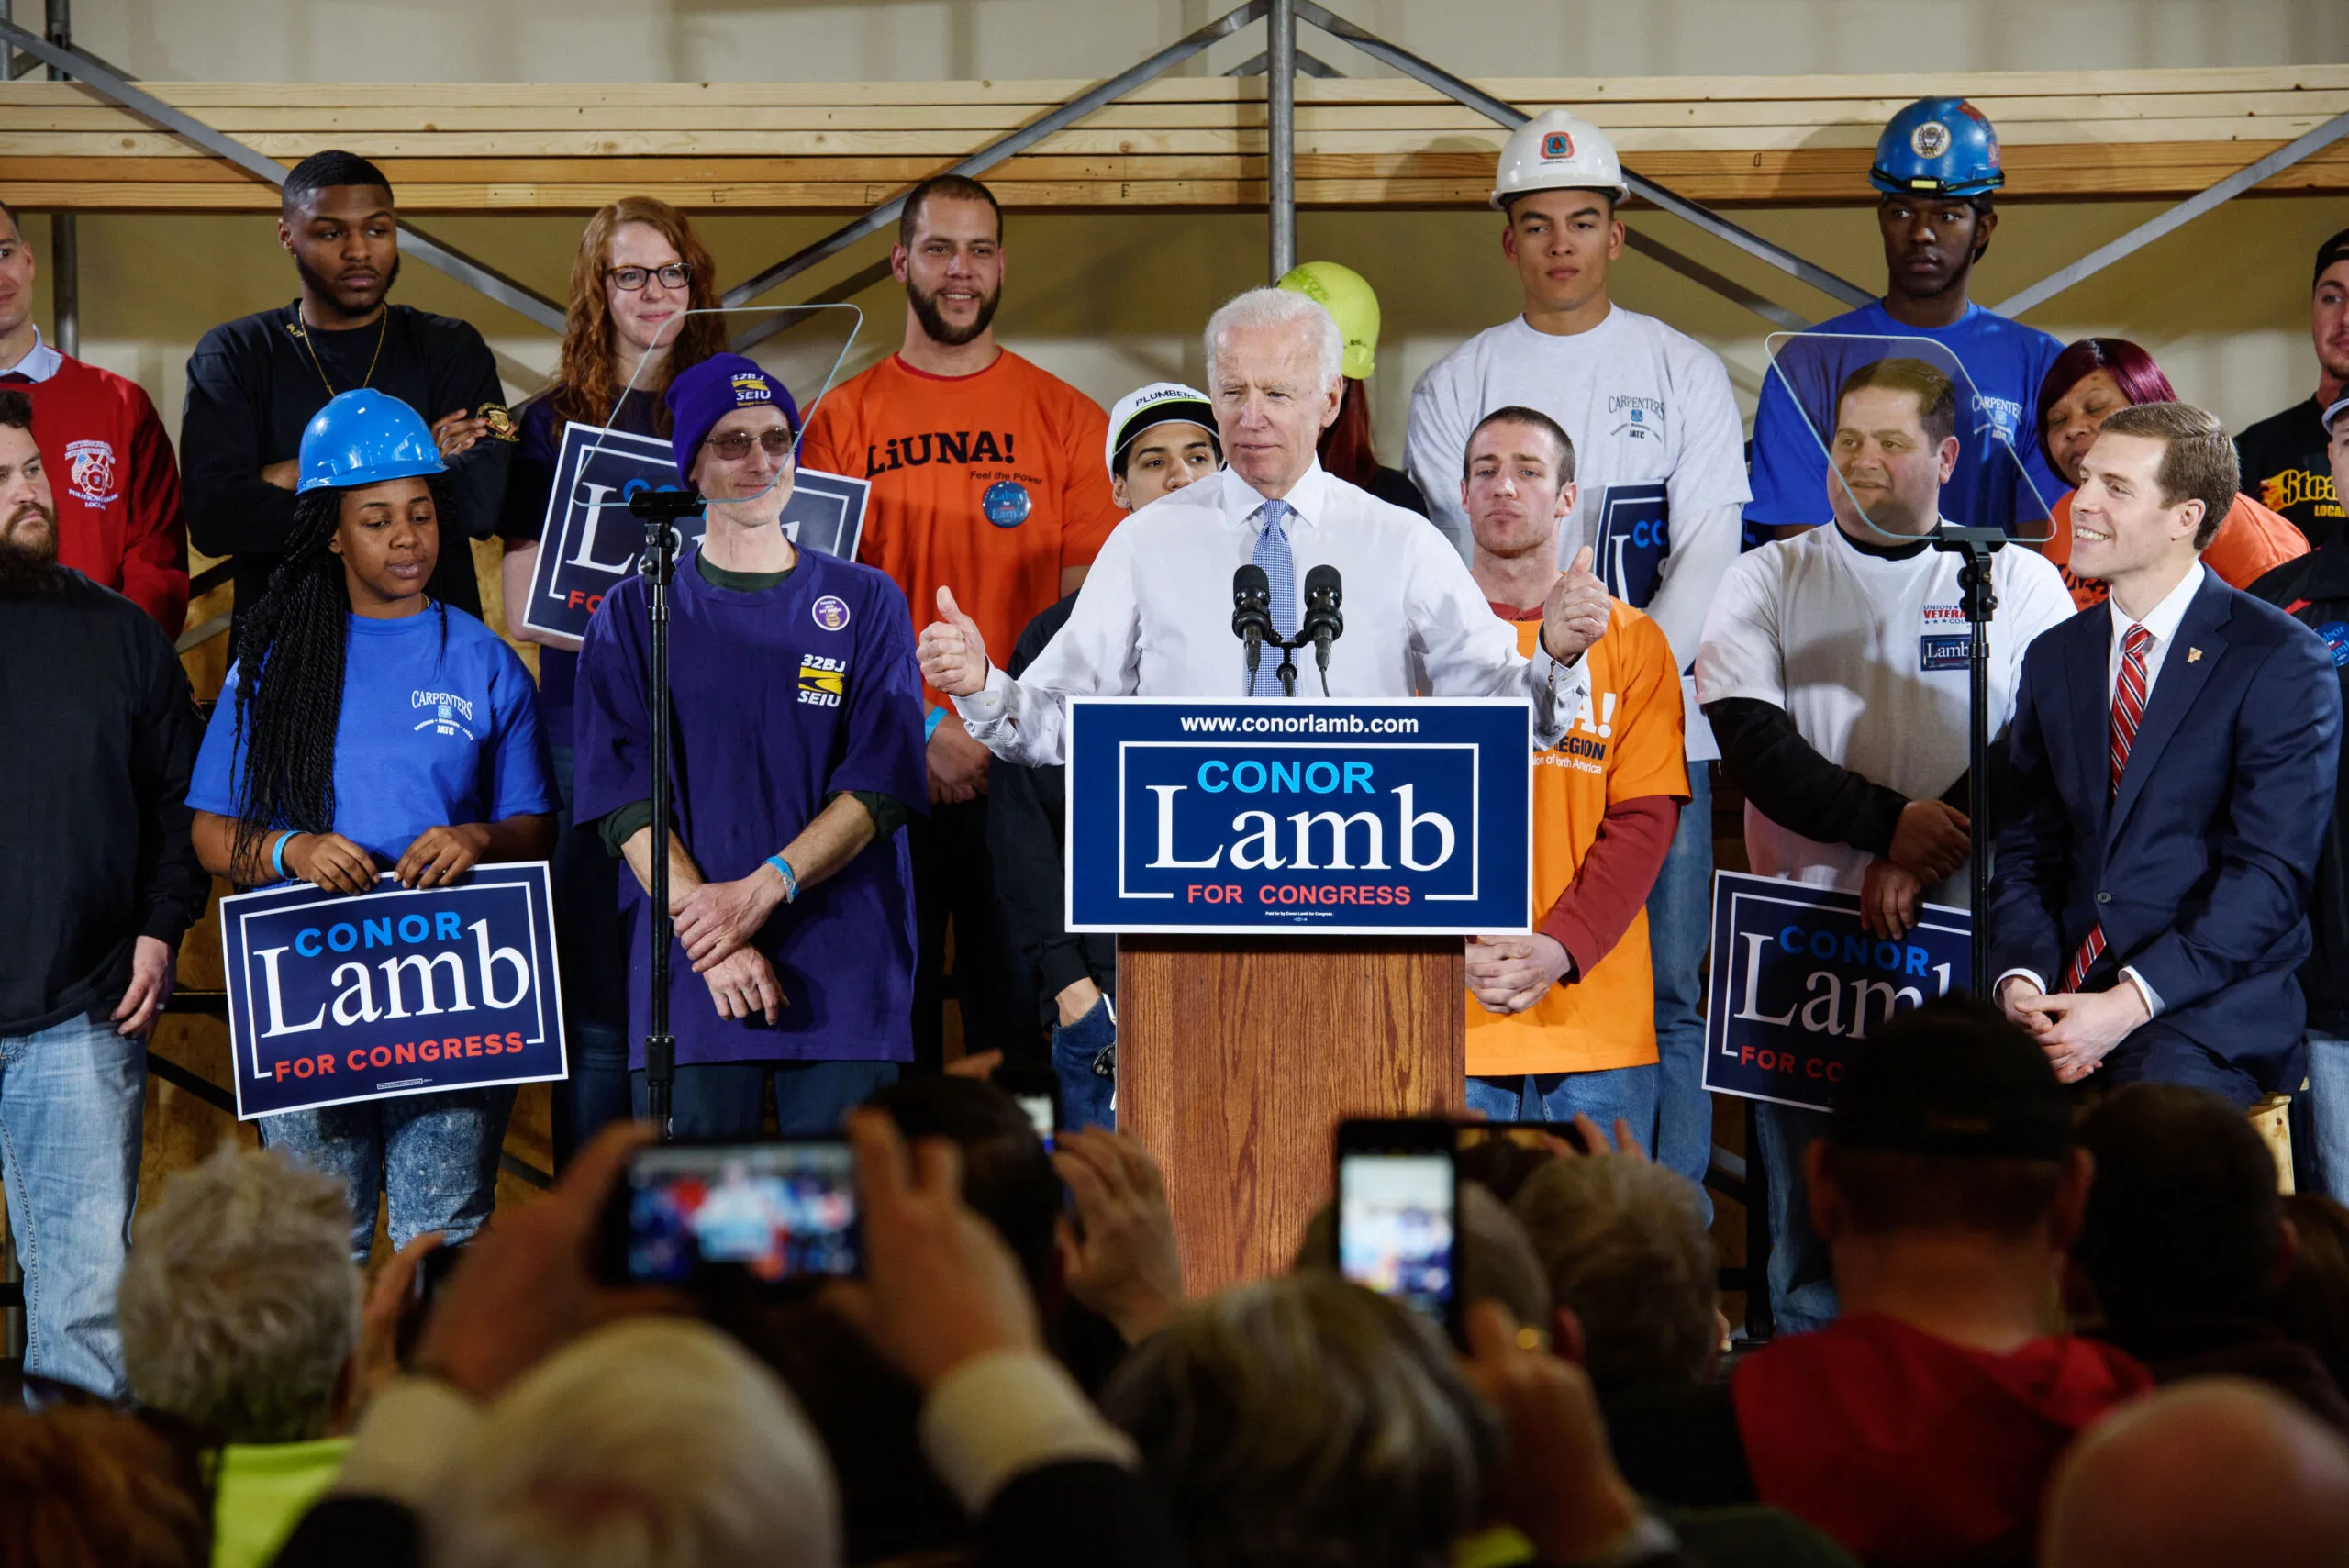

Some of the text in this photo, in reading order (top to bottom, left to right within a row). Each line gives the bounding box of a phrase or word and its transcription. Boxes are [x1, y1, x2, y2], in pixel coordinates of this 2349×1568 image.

[736, 390, 771, 401] SEIU
[1609, 395, 1665, 421] CARPENTERS
[865, 431, 1015, 479] LiUNA!
[970, 471, 991, 480] Feel
[994, 471, 1010, 480] the
[2281, 469, 2339, 506] Stea
[1923, 610, 1966, 619] VETERA
[801, 653, 846, 673] 32BJ
[411, 690, 473, 721] CARPENTERS
[797, 690, 841, 707] SEIU
[1181, 714, 1419, 734] www.conorlamb.com
[1553, 736, 1606, 761] EGION
[1197, 760, 1376, 794] CONOR
[1145, 783, 1456, 872] Lamb
[1187, 884, 1411, 906] FOR CONGRESS
[295, 911, 462, 958] CONOR
[1779, 925, 1929, 977] CONOR
[253, 918, 529, 1039] Lamb
[275, 1032, 523, 1083] FOR CONGRESS
[1741, 1046, 1796, 1074] FOR
